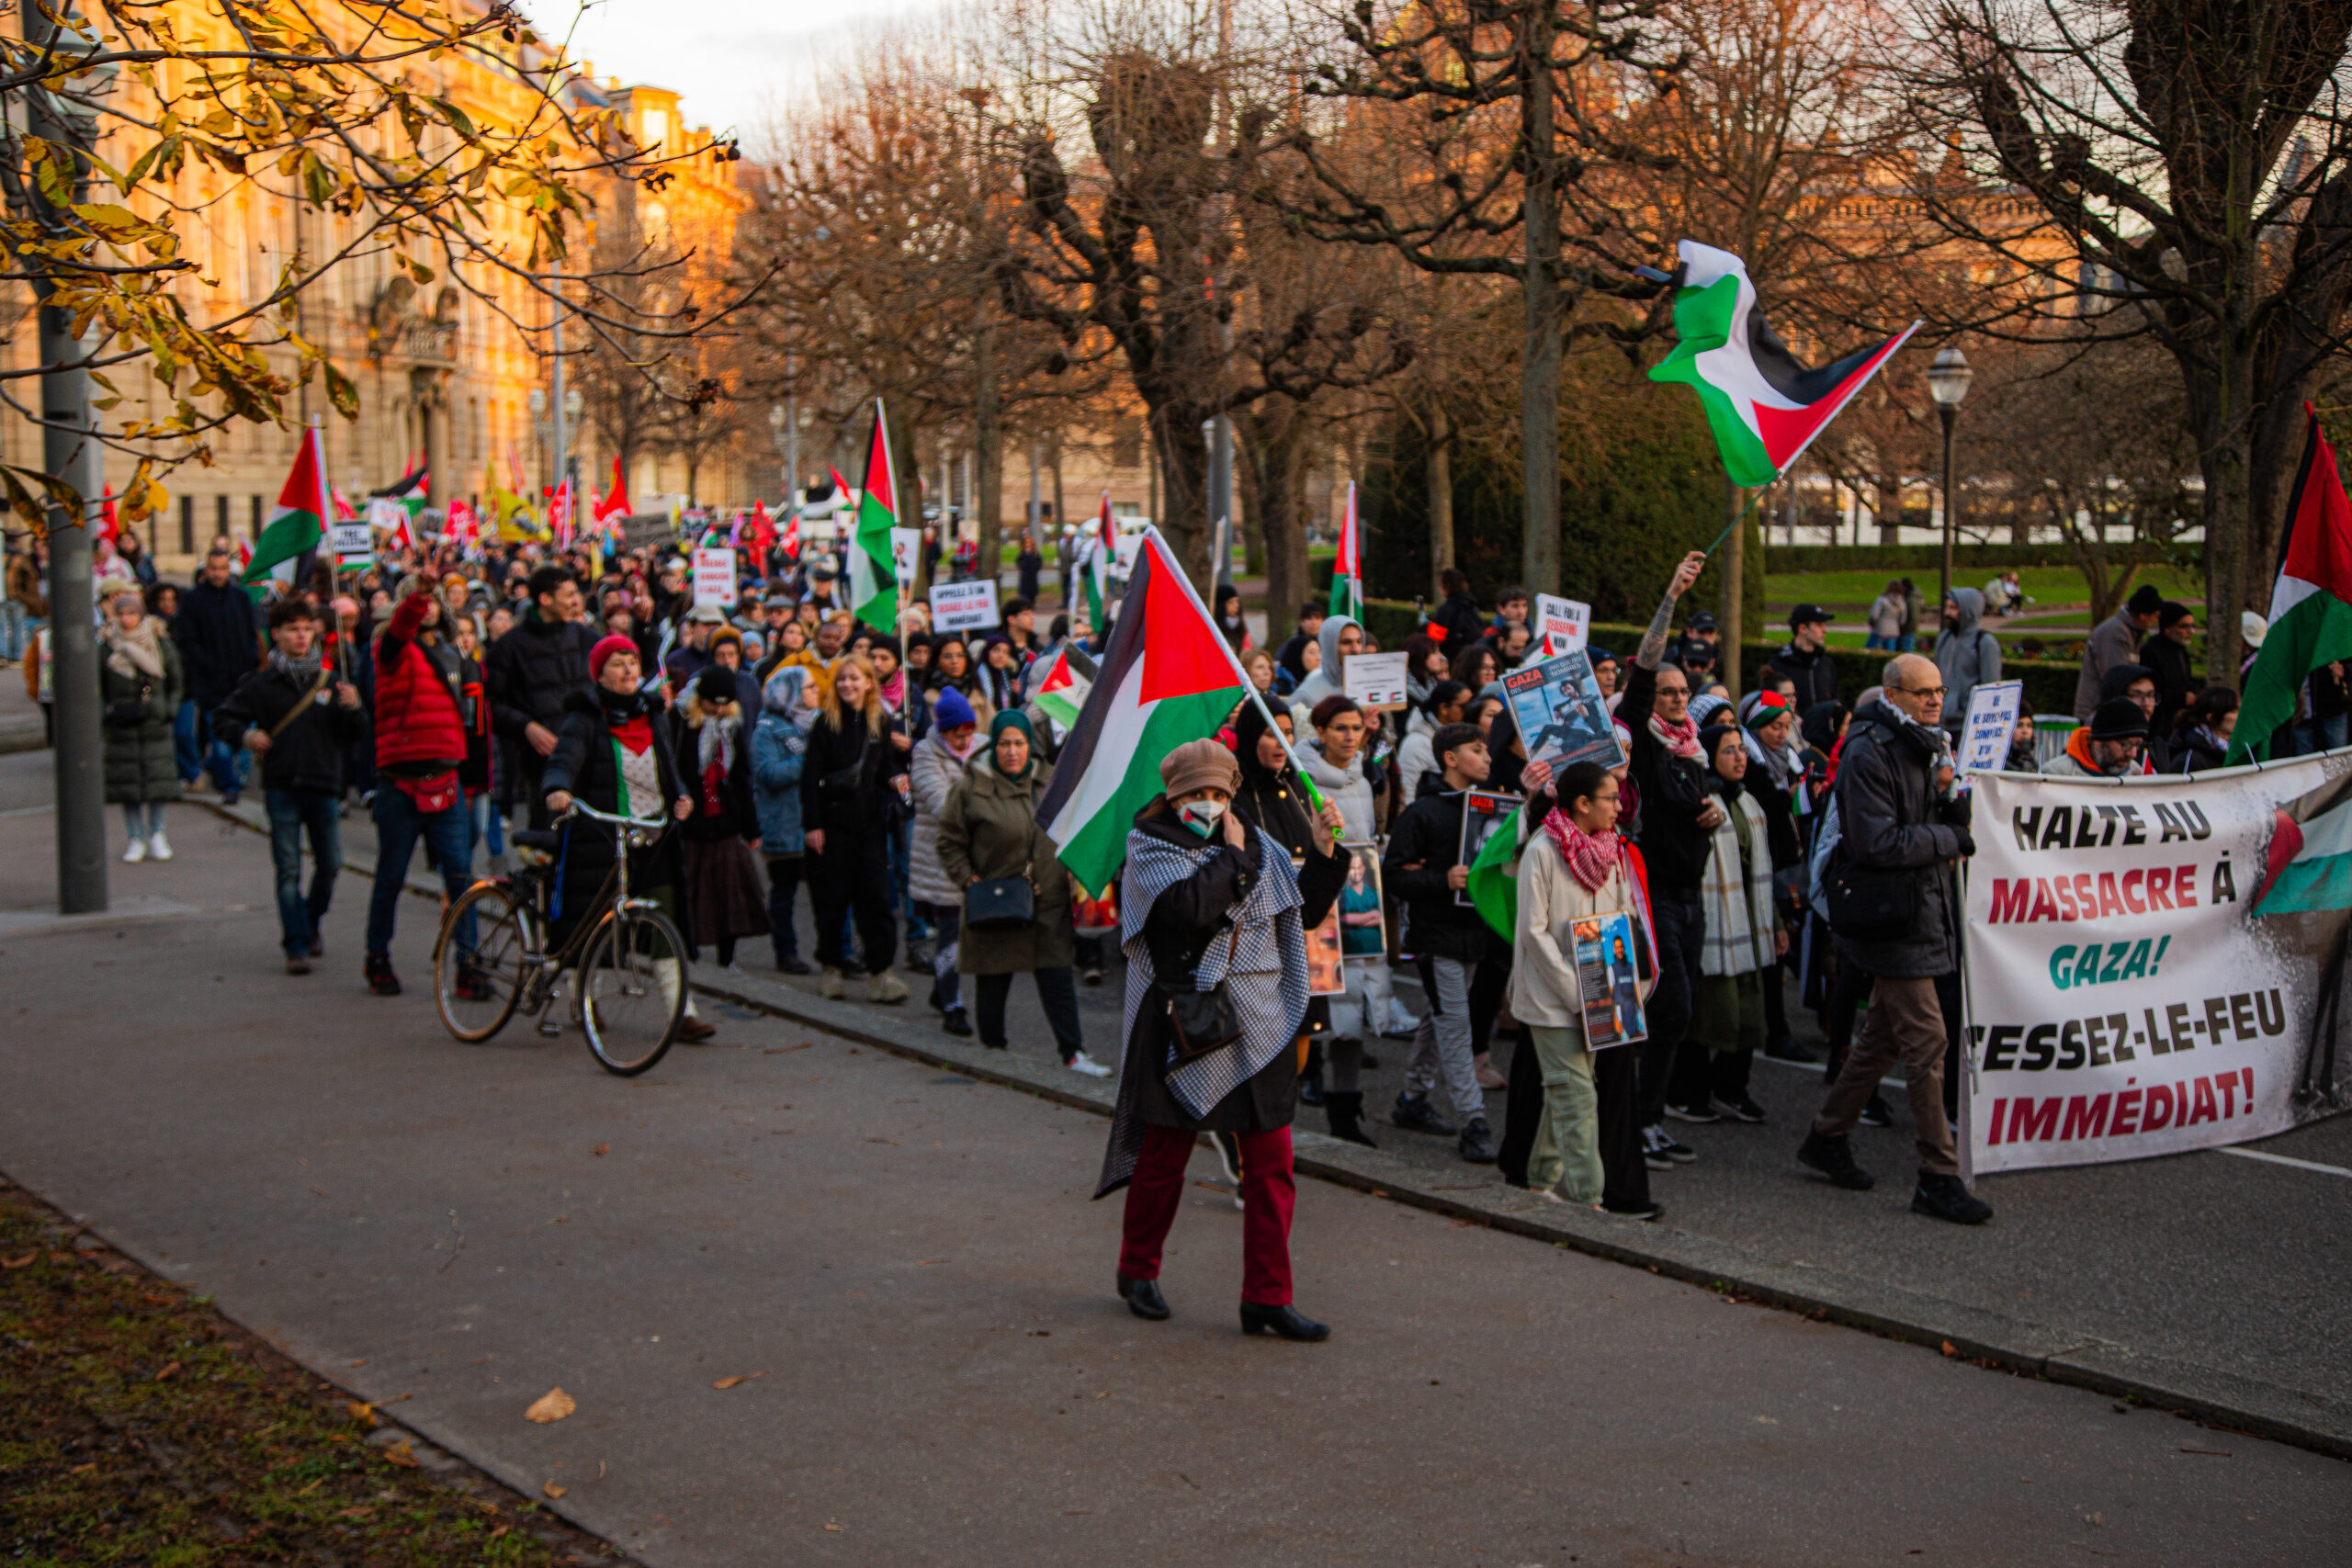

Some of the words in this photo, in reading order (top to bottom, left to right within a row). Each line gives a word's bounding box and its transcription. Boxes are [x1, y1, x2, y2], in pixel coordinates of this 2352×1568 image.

[1546, 603, 1563, 617] CALL
[1564, 606, 1575, 620] FOR
[1576, 609, 1581, 622] A
[1545, 618, 1577, 637] CEASEFIRE
[1554, 636, 1567, 649] NOW
[1506, 669, 1544, 689] GAZA
[1510, 686, 1522, 695] DES
[1470, 796, 1494, 807] GAZA
[2013, 805, 2147, 852] HALTE
[2152, 800, 2211, 843] AU
[1988, 863, 2198, 924] MASSACRE
[2211, 850, 2236, 905] À
[2049, 934, 2172, 991] GAZA!
[1987, 1066, 2255, 1146] IMMÉDIAT!
